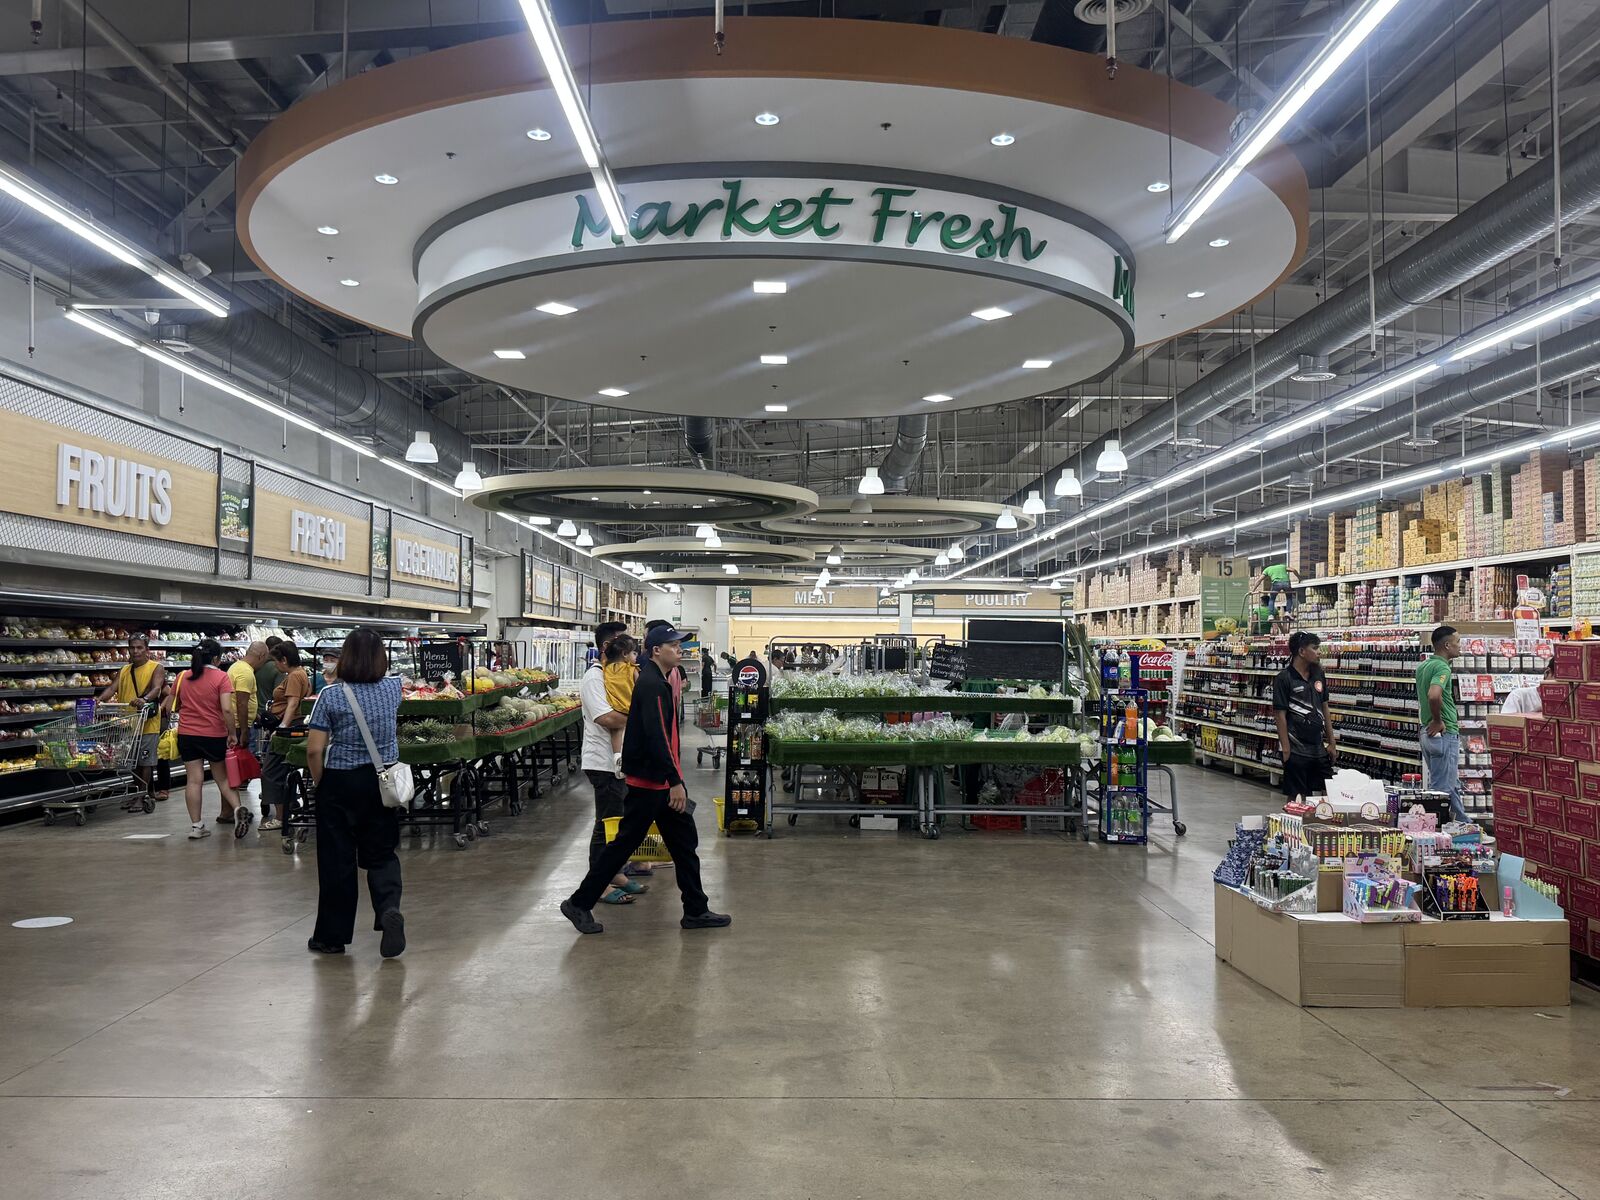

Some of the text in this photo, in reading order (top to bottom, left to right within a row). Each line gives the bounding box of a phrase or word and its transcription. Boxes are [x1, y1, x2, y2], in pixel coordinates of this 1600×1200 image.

[571, 180, 1047, 261] Market Fresh
[57, 442, 172, 525] FRUITS
[290, 508, 346, 561] FRESH
[395, 538, 459, 583] VEGETABLES
[1216, 560, 1233, 576] 15
[794, 591, 836, 605] MEAT
[965, 593, 1029, 607] POULTRY
[424, 651, 448, 661] Menzi
[425, 661, 452, 670] Pomelo
